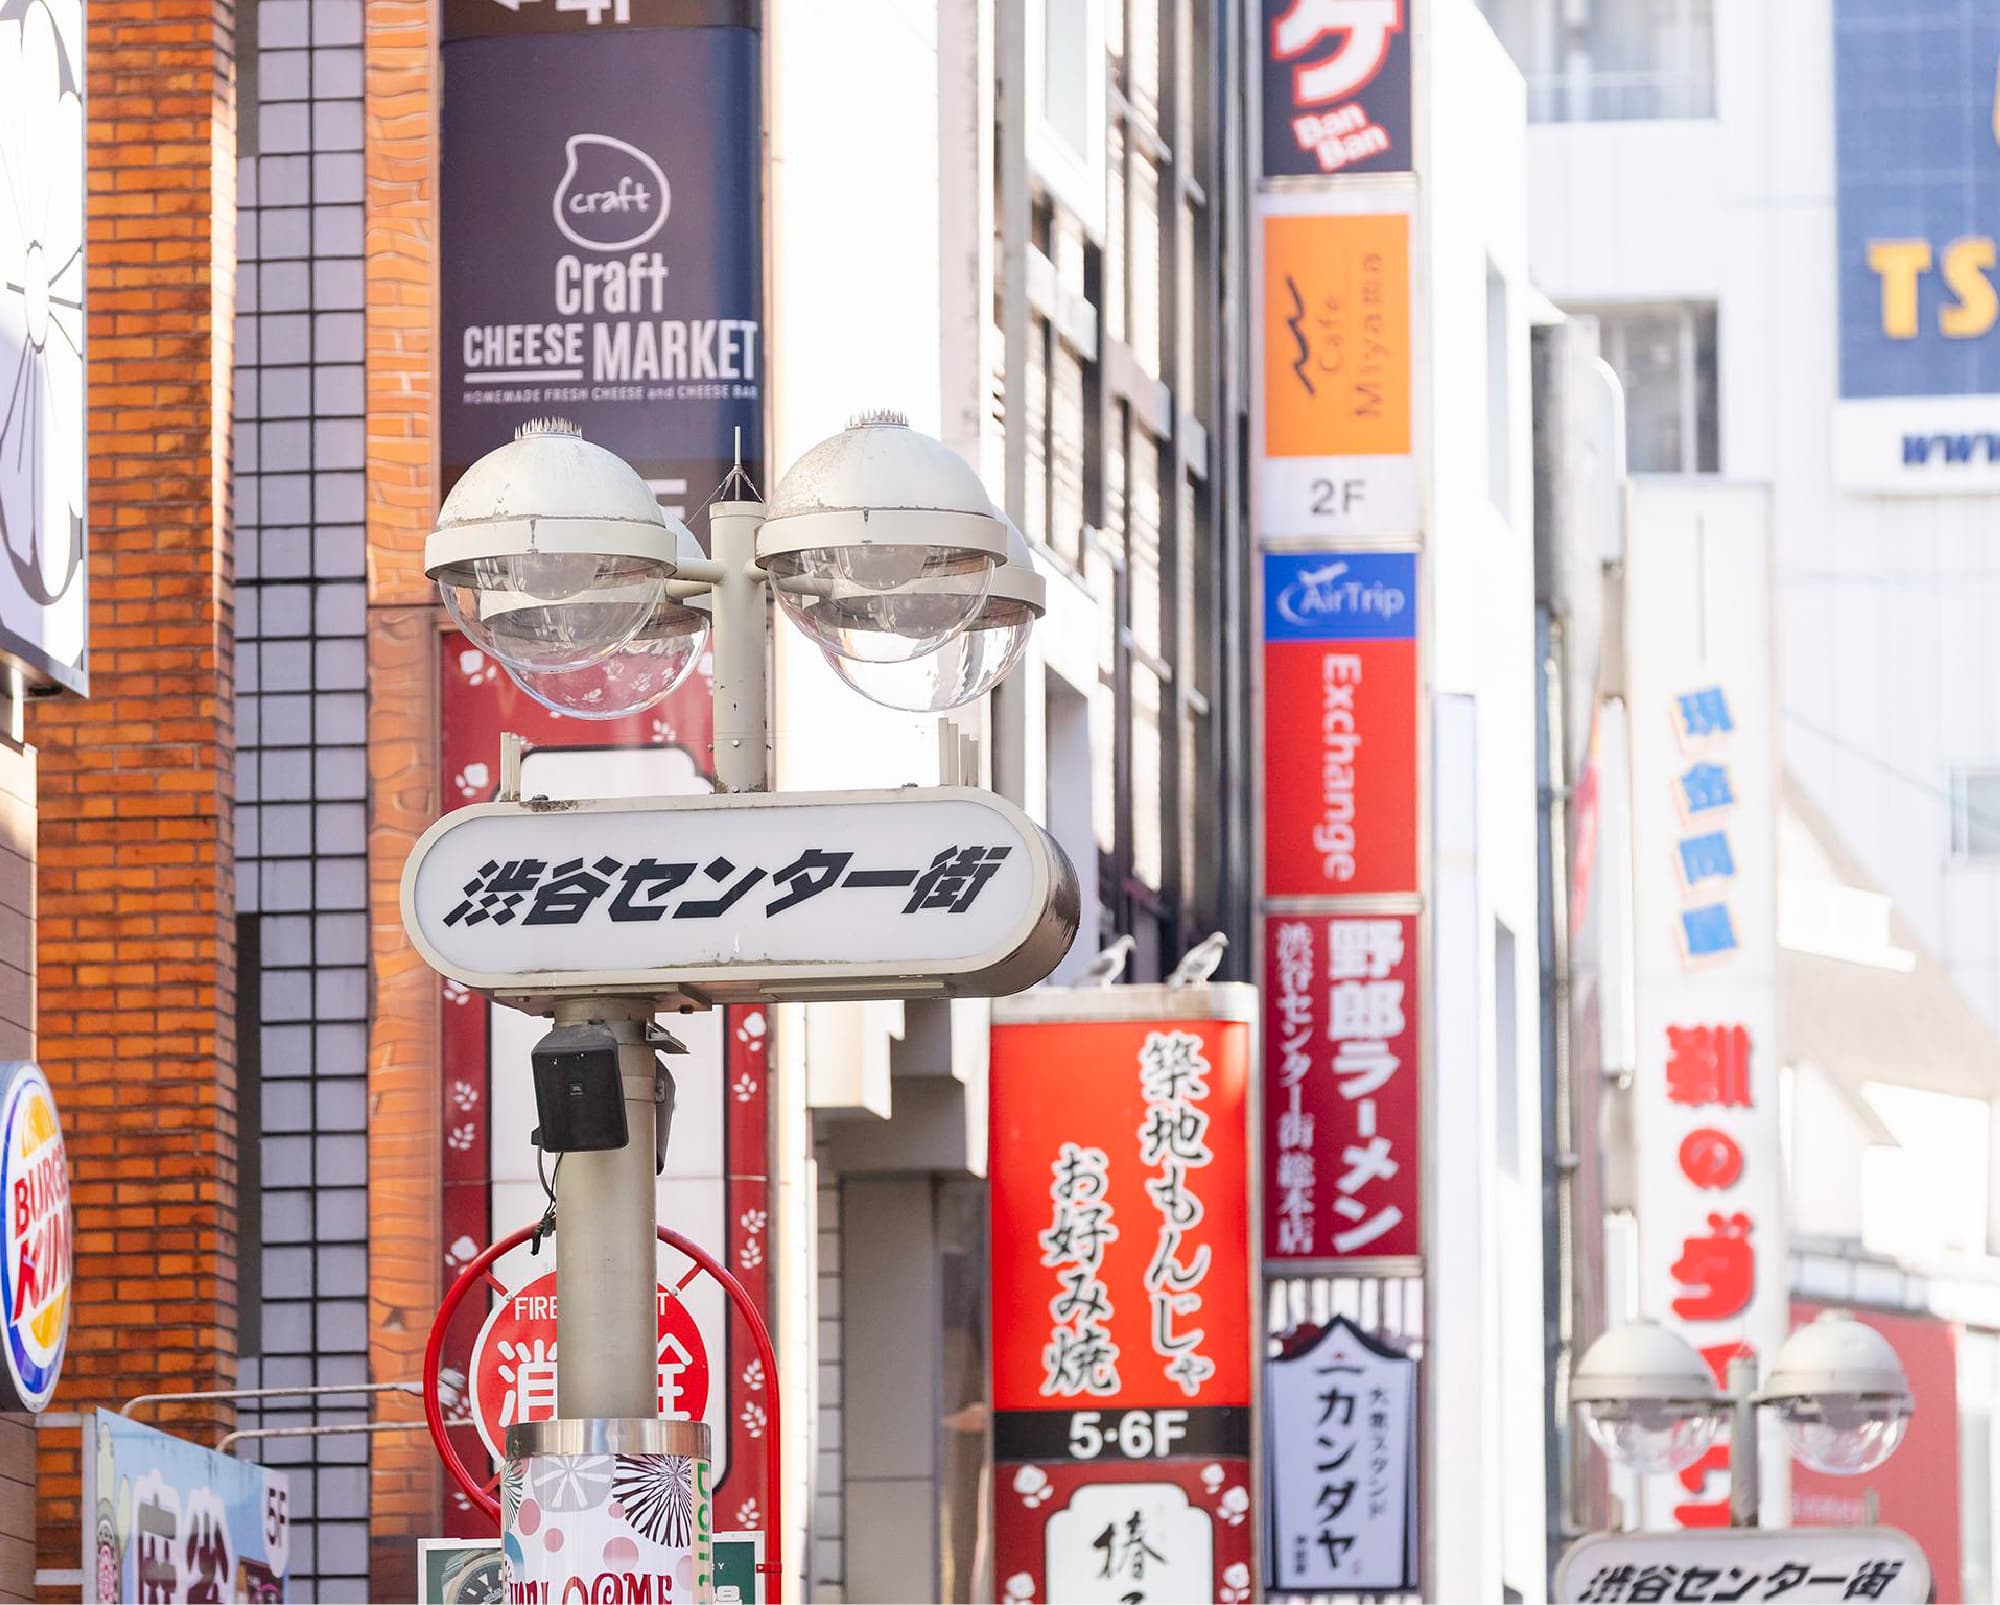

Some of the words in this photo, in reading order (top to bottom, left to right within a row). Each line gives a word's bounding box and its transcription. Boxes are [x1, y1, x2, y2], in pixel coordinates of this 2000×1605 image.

[1292, 103, 1369, 150] Ban
[1316, 125, 1392, 173] Ban
[569, 177, 651, 214] craft
[555, 253, 668, 315] Craft
[463, 323, 583, 368] CHEESE
[592, 319, 758, 381] MARKET
[1319, 295, 1343, 376] Cafe
[1355, 253, 1386, 418] Miyama
[463, 389, 540, 404] HOMEMADE
[544, 387, 588, 402] FRESH
[592, 386, 643, 401] CHEESE
[677, 384, 729, 399] CHEESE
[1309, 479, 1367, 515] 2F
[1301, 581, 1406, 619] AirTrip
[1313, 653, 1362, 881] Exchange
[442, 845, 1012, 928] 渋谷センター街
[1328, 920, 1405, 1253] 野郎ラーメン
[1138, 1031, 1214, 1396] 築地もんじゃ
[14, 1207, 72, 1321] KIN
[1039, 1142, 1120, 1396] お好み焼
[1314, 1387, 1358, 1570] カンダヤ
[1577, 1557, 1907, 1604] 渋谷センター街
